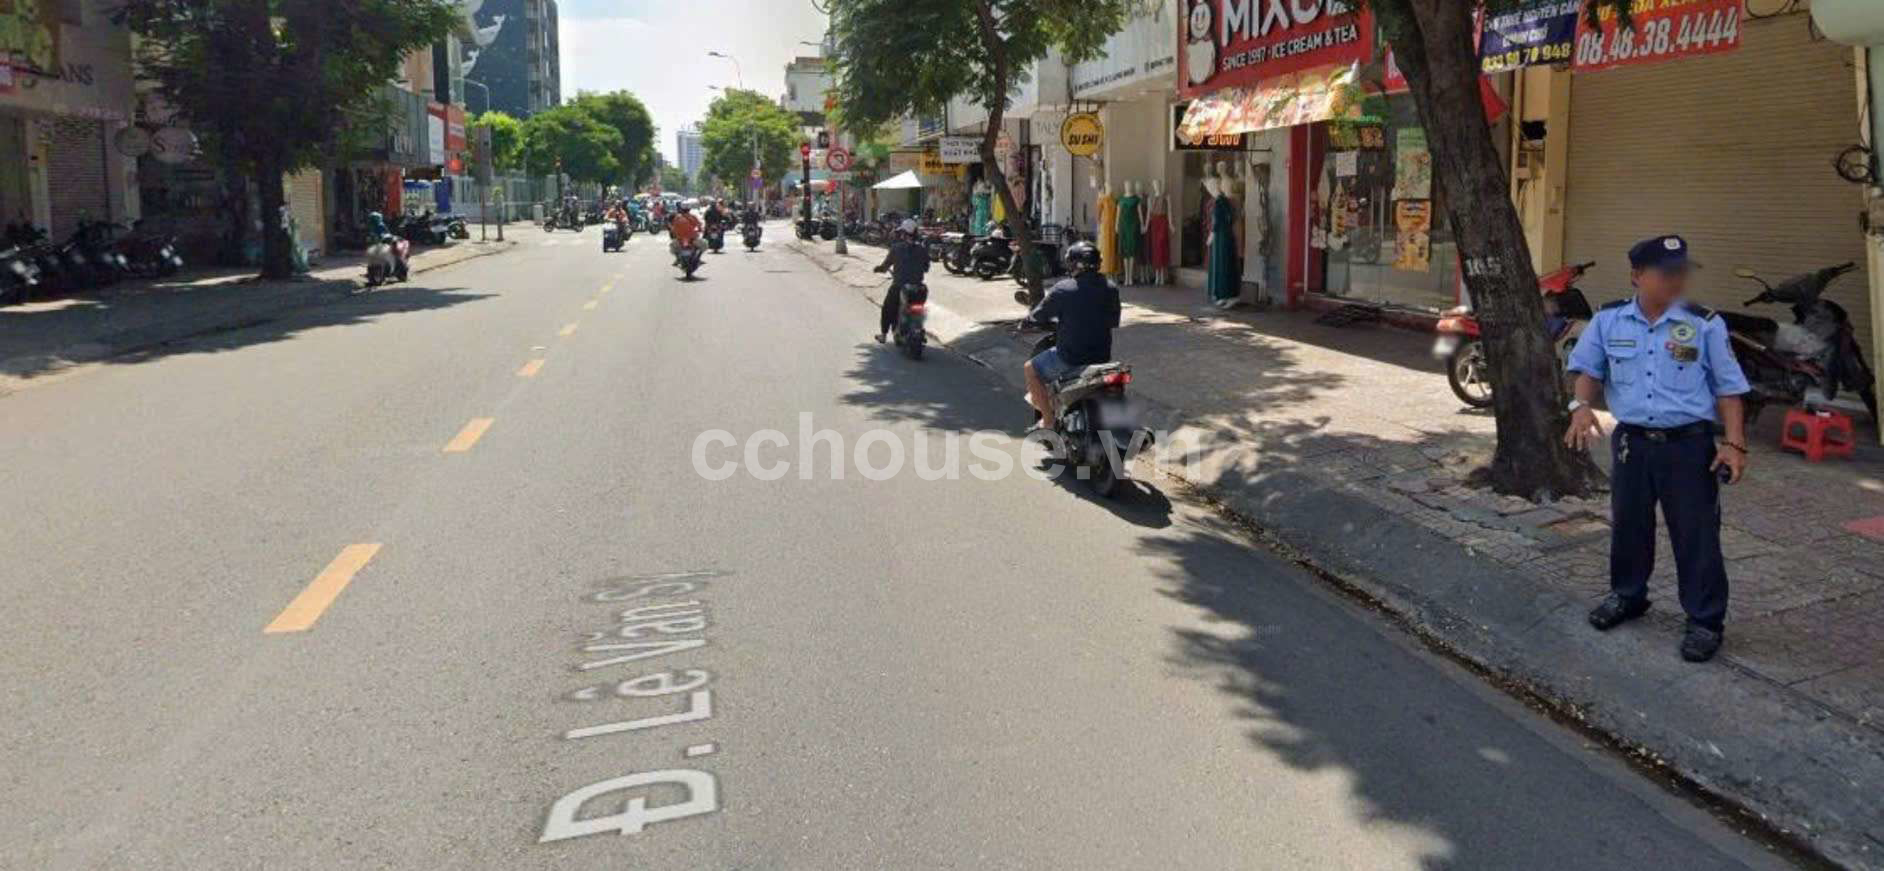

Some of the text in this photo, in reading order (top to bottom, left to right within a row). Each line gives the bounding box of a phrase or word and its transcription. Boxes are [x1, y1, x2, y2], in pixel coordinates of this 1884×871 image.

[1222, 25, 1358, 71] SINCE 1997 ICE CREAM & TEA
[1542, 42, 1572, 60] 948
